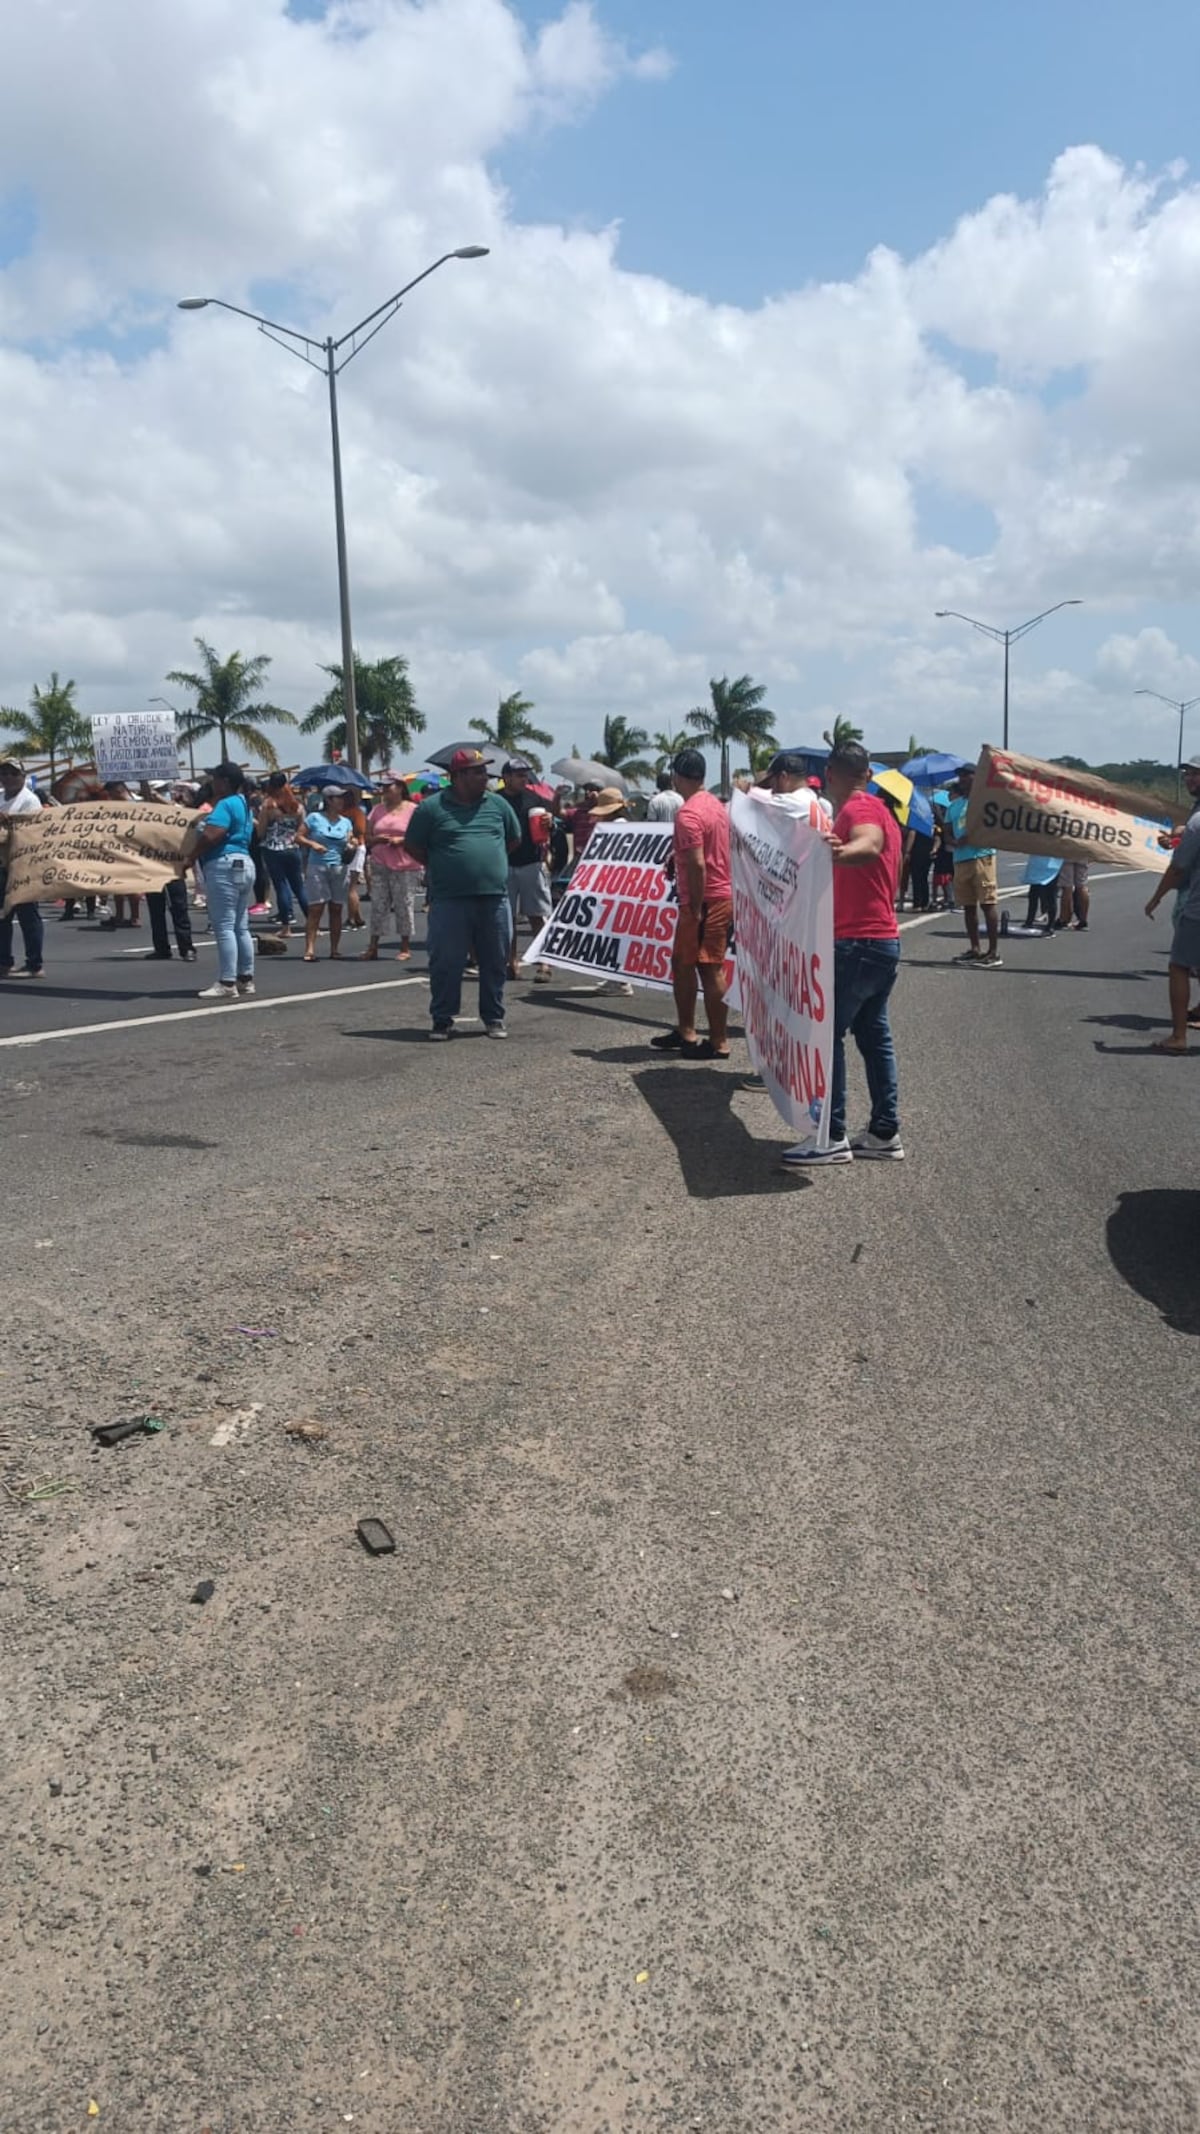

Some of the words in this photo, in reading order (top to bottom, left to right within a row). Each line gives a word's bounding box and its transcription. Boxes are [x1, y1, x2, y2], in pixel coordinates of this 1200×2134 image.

[111, 735, 173, 748] REEMBOLSAR
[72, 823, 118, 838] agua
[983, 801, 1133, 847] Soluciones
[583, 832, 675, 865] EXIGIMO
[567, 864, 597, 891] 24
[590, 865, 667, 901] HORAS
[596, 899, 616, 930] 7
[624, 941, 674, 979] BAS
[781, 935, 826, 1023] HORAS
